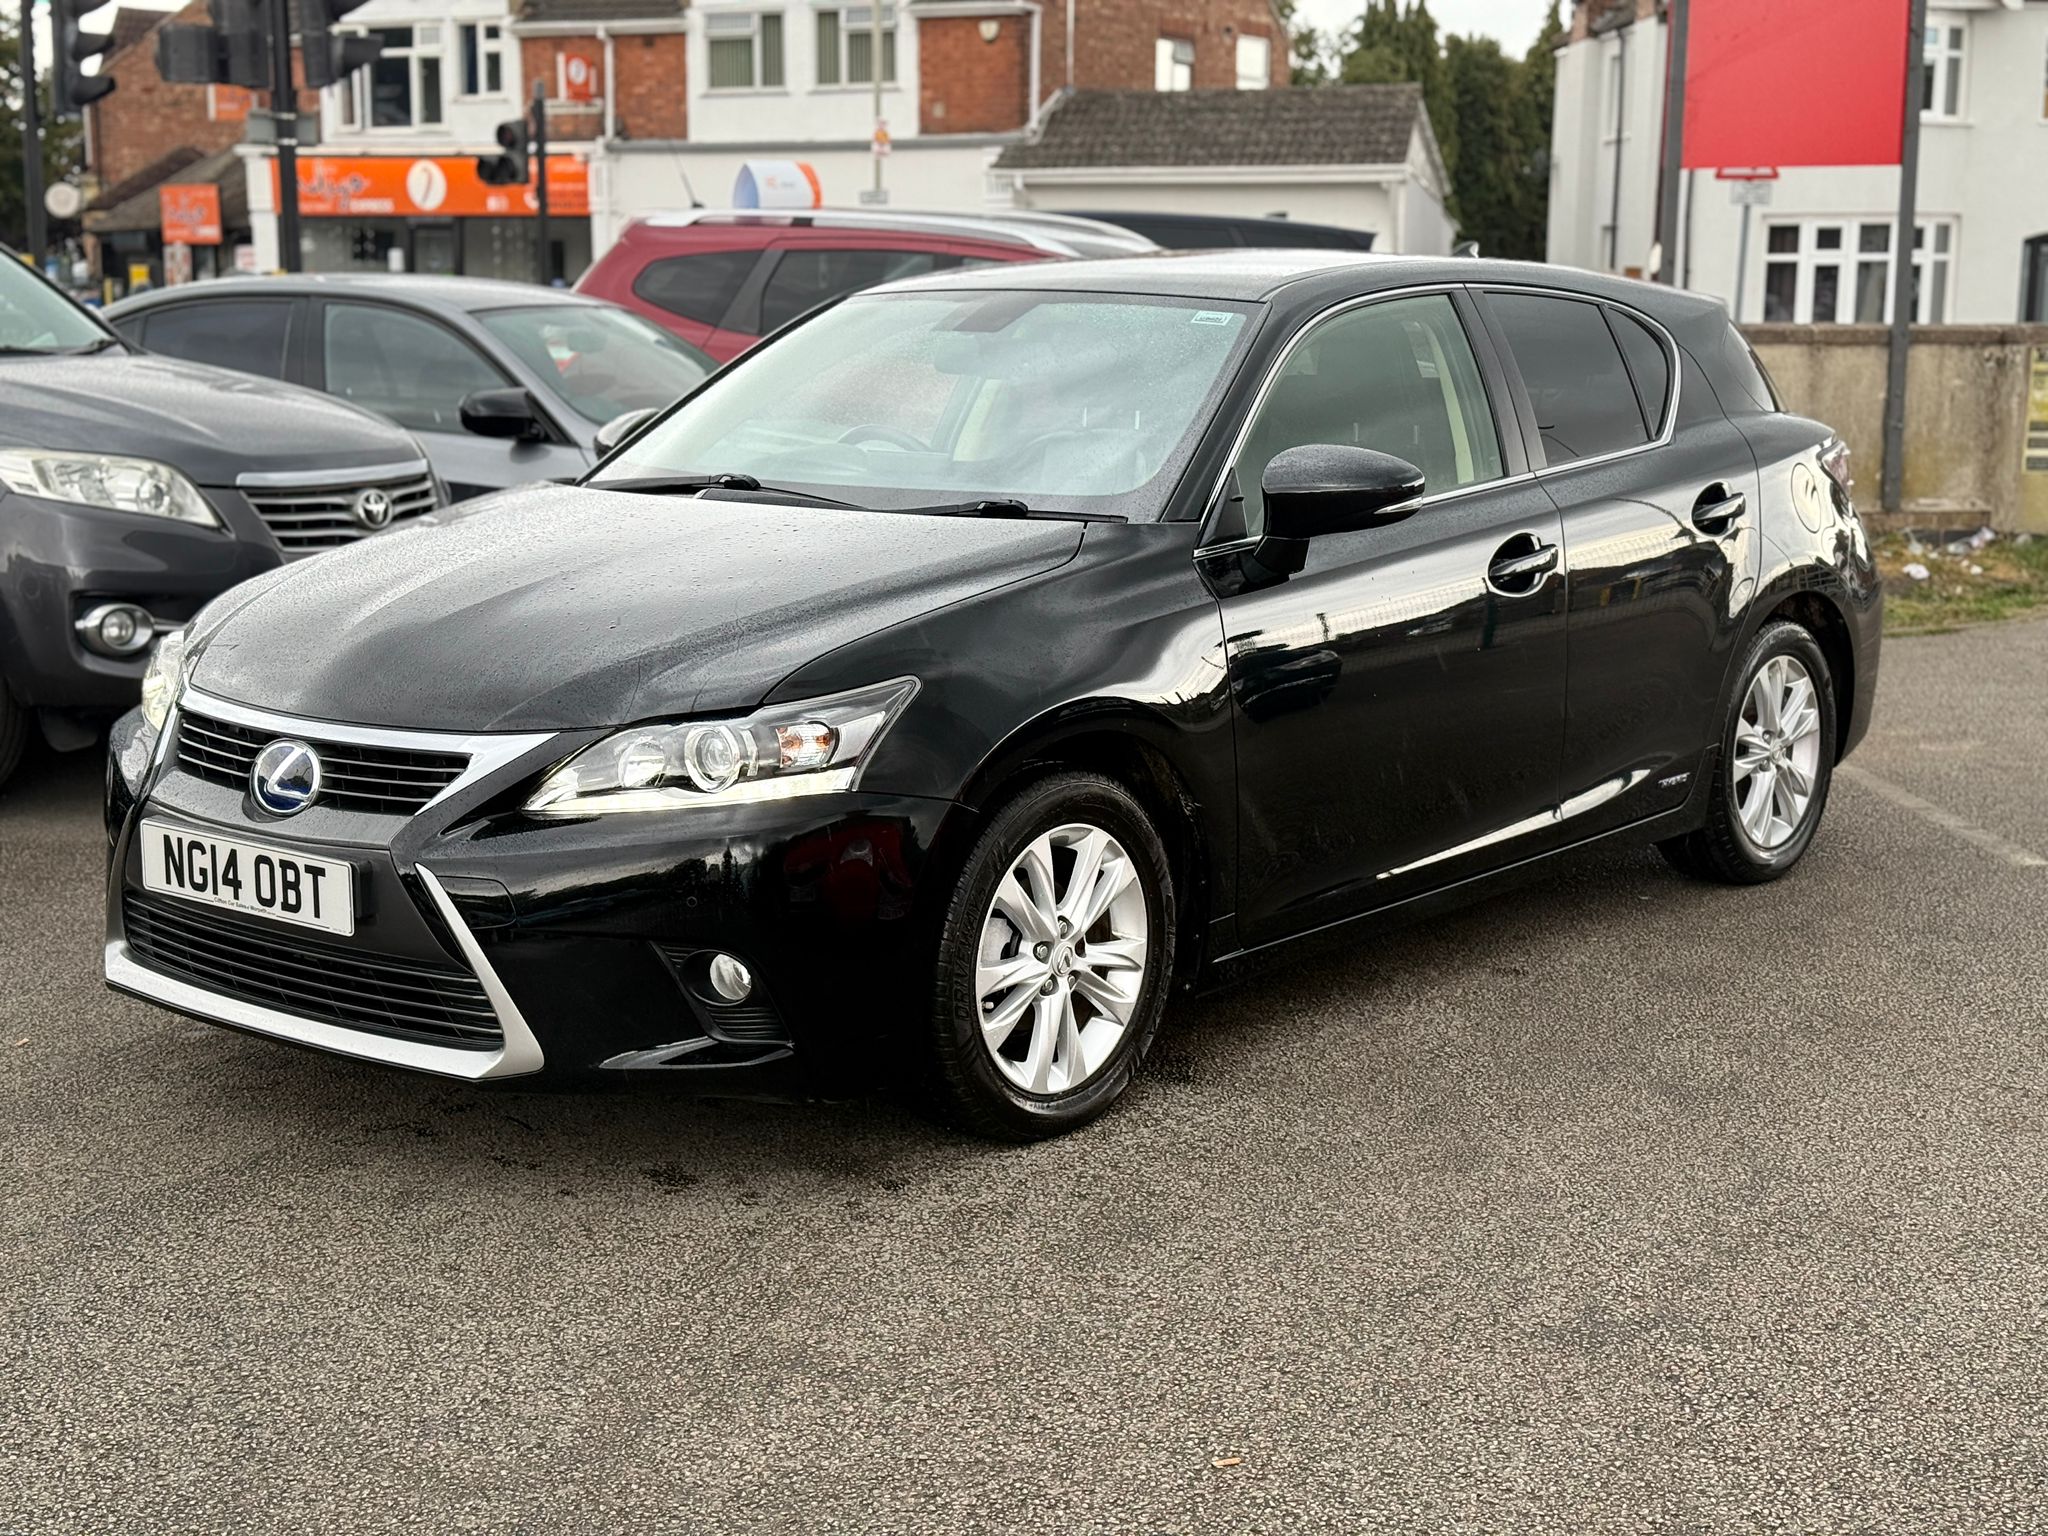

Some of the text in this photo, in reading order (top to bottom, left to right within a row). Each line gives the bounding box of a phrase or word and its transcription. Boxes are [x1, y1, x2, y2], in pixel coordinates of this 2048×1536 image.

[163, 833, 327, 919] NG14 OBT
[227, 899, 235, 907] Car
